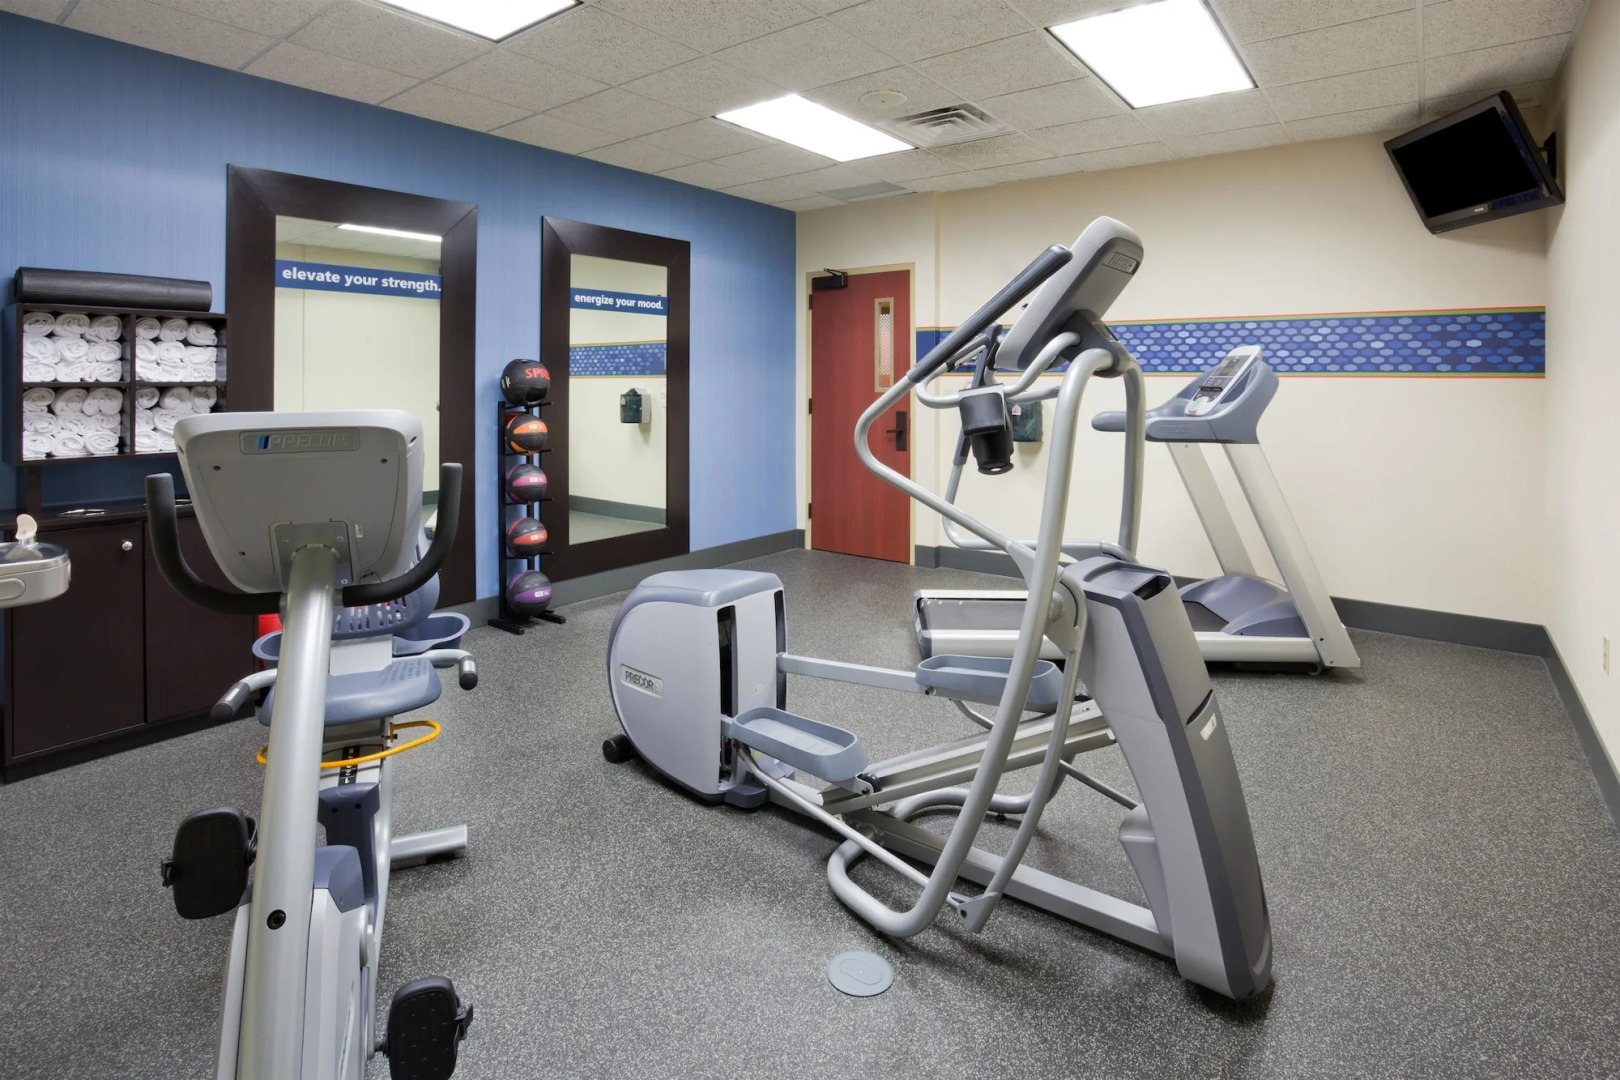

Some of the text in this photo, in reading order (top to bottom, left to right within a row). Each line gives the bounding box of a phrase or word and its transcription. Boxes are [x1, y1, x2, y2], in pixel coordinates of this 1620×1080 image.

[282, 267, 442, 293] elevate your strength.
[574, 294, 664, 309] energize your mood.
[625, 670, 654, 691] PRECOR
